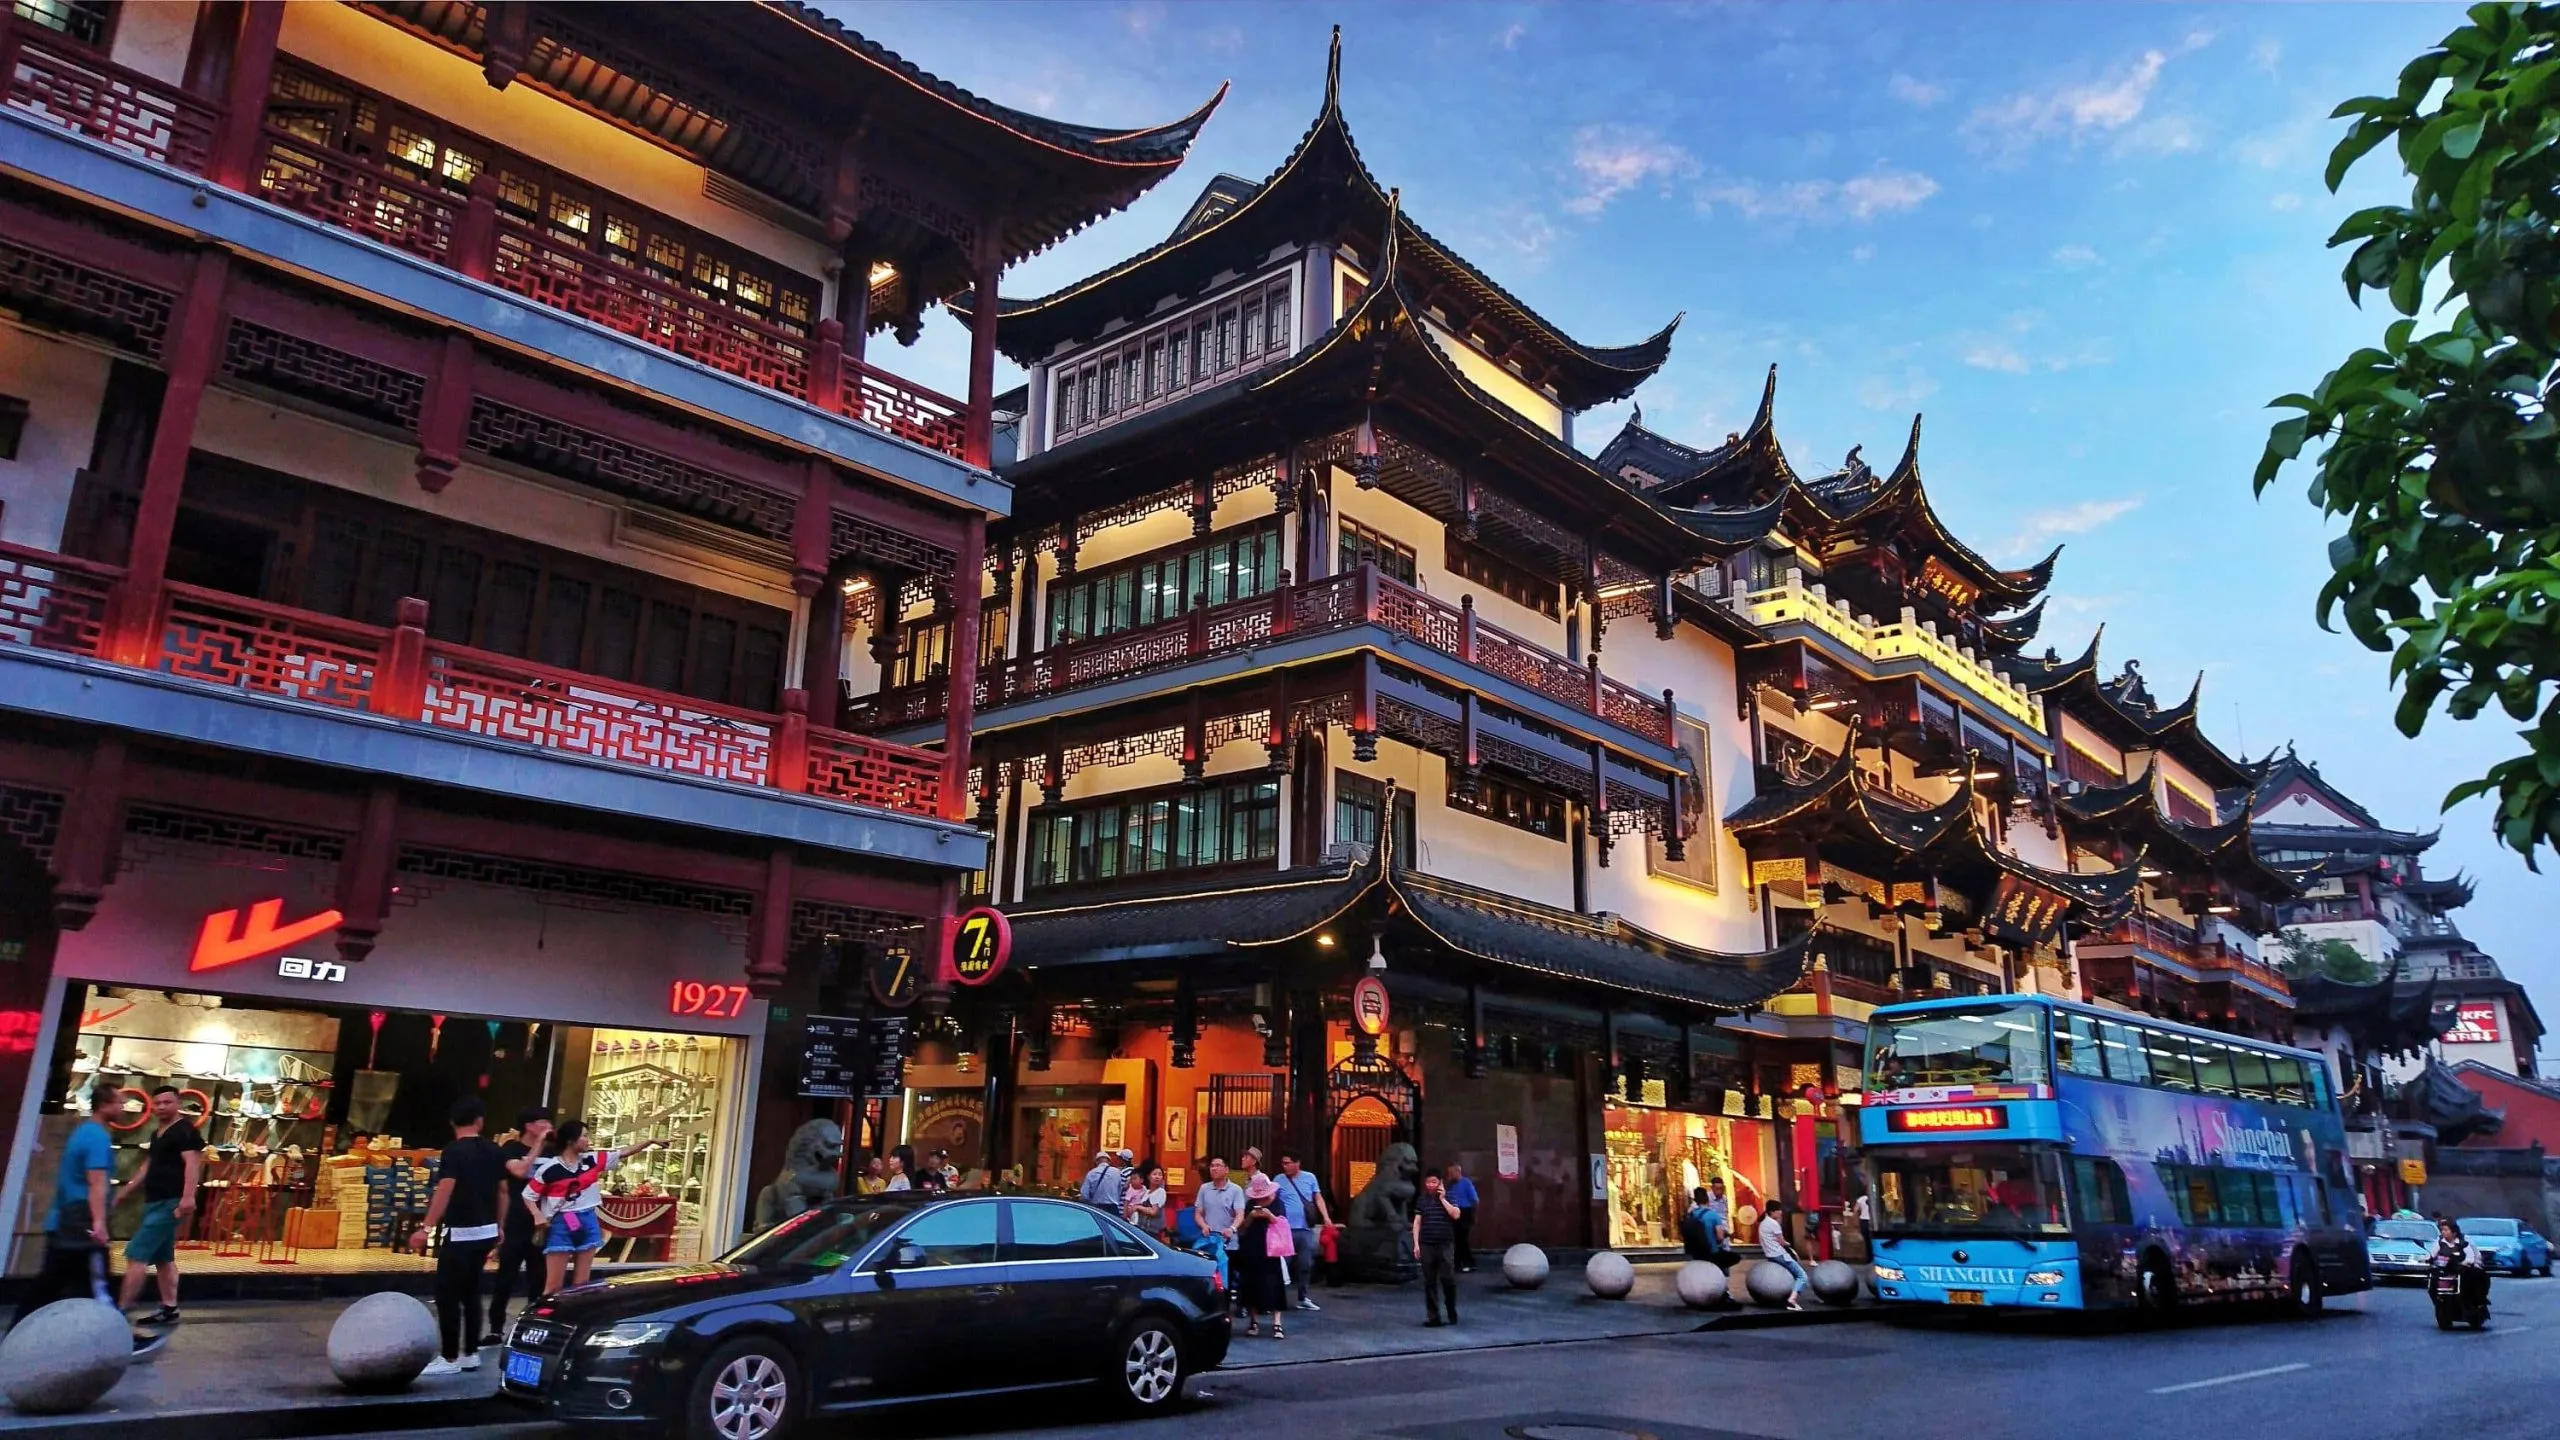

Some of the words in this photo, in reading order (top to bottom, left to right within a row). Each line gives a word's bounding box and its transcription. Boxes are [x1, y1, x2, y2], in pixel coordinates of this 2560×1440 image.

[963, 917, 989, 958] 7
[278, 957, 346, 982] 回力
[886, 955, 910, 997] 7
[672, 981, 748, 1017] 1927
[2461, 1010, 2494, 1020] KFC
[1984, 1107, 1994, 1125] 1
[1919, 1266, 2016, 1284] SHANGHAI
